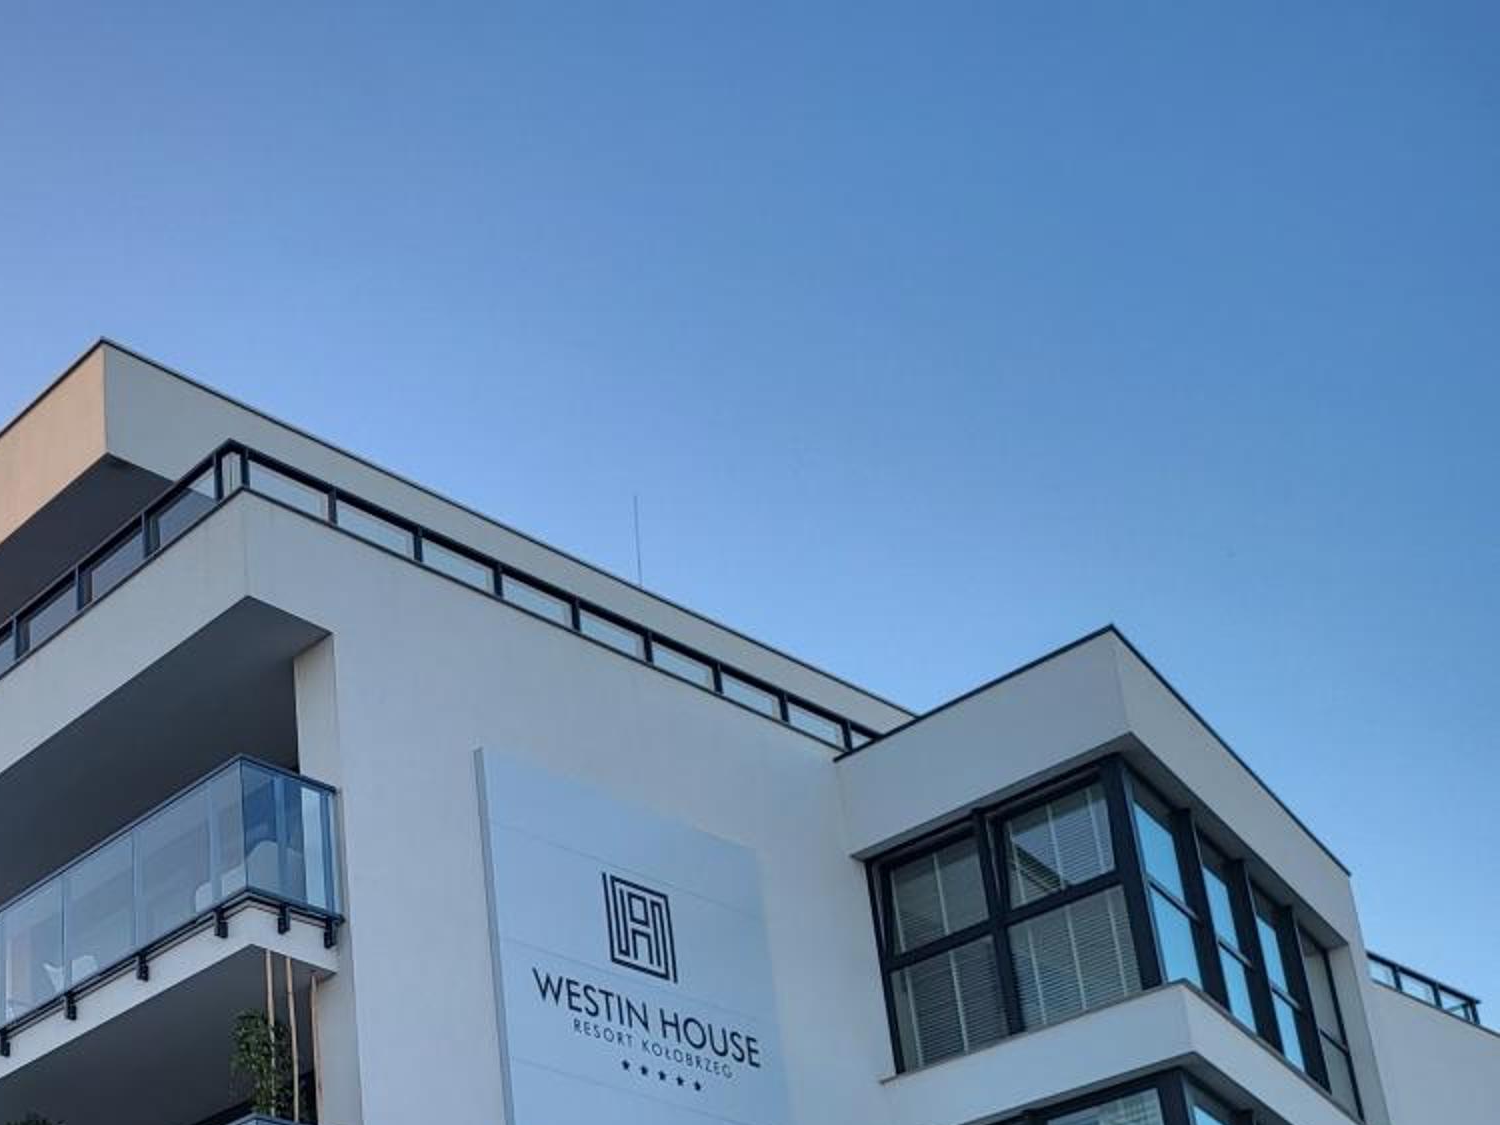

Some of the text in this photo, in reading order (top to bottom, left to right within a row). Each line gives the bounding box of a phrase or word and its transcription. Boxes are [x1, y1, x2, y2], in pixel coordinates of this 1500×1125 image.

[532, 967, 761, 1068] WESTIN HOUSE
[573, 1018, 633, 1048] RESORT
